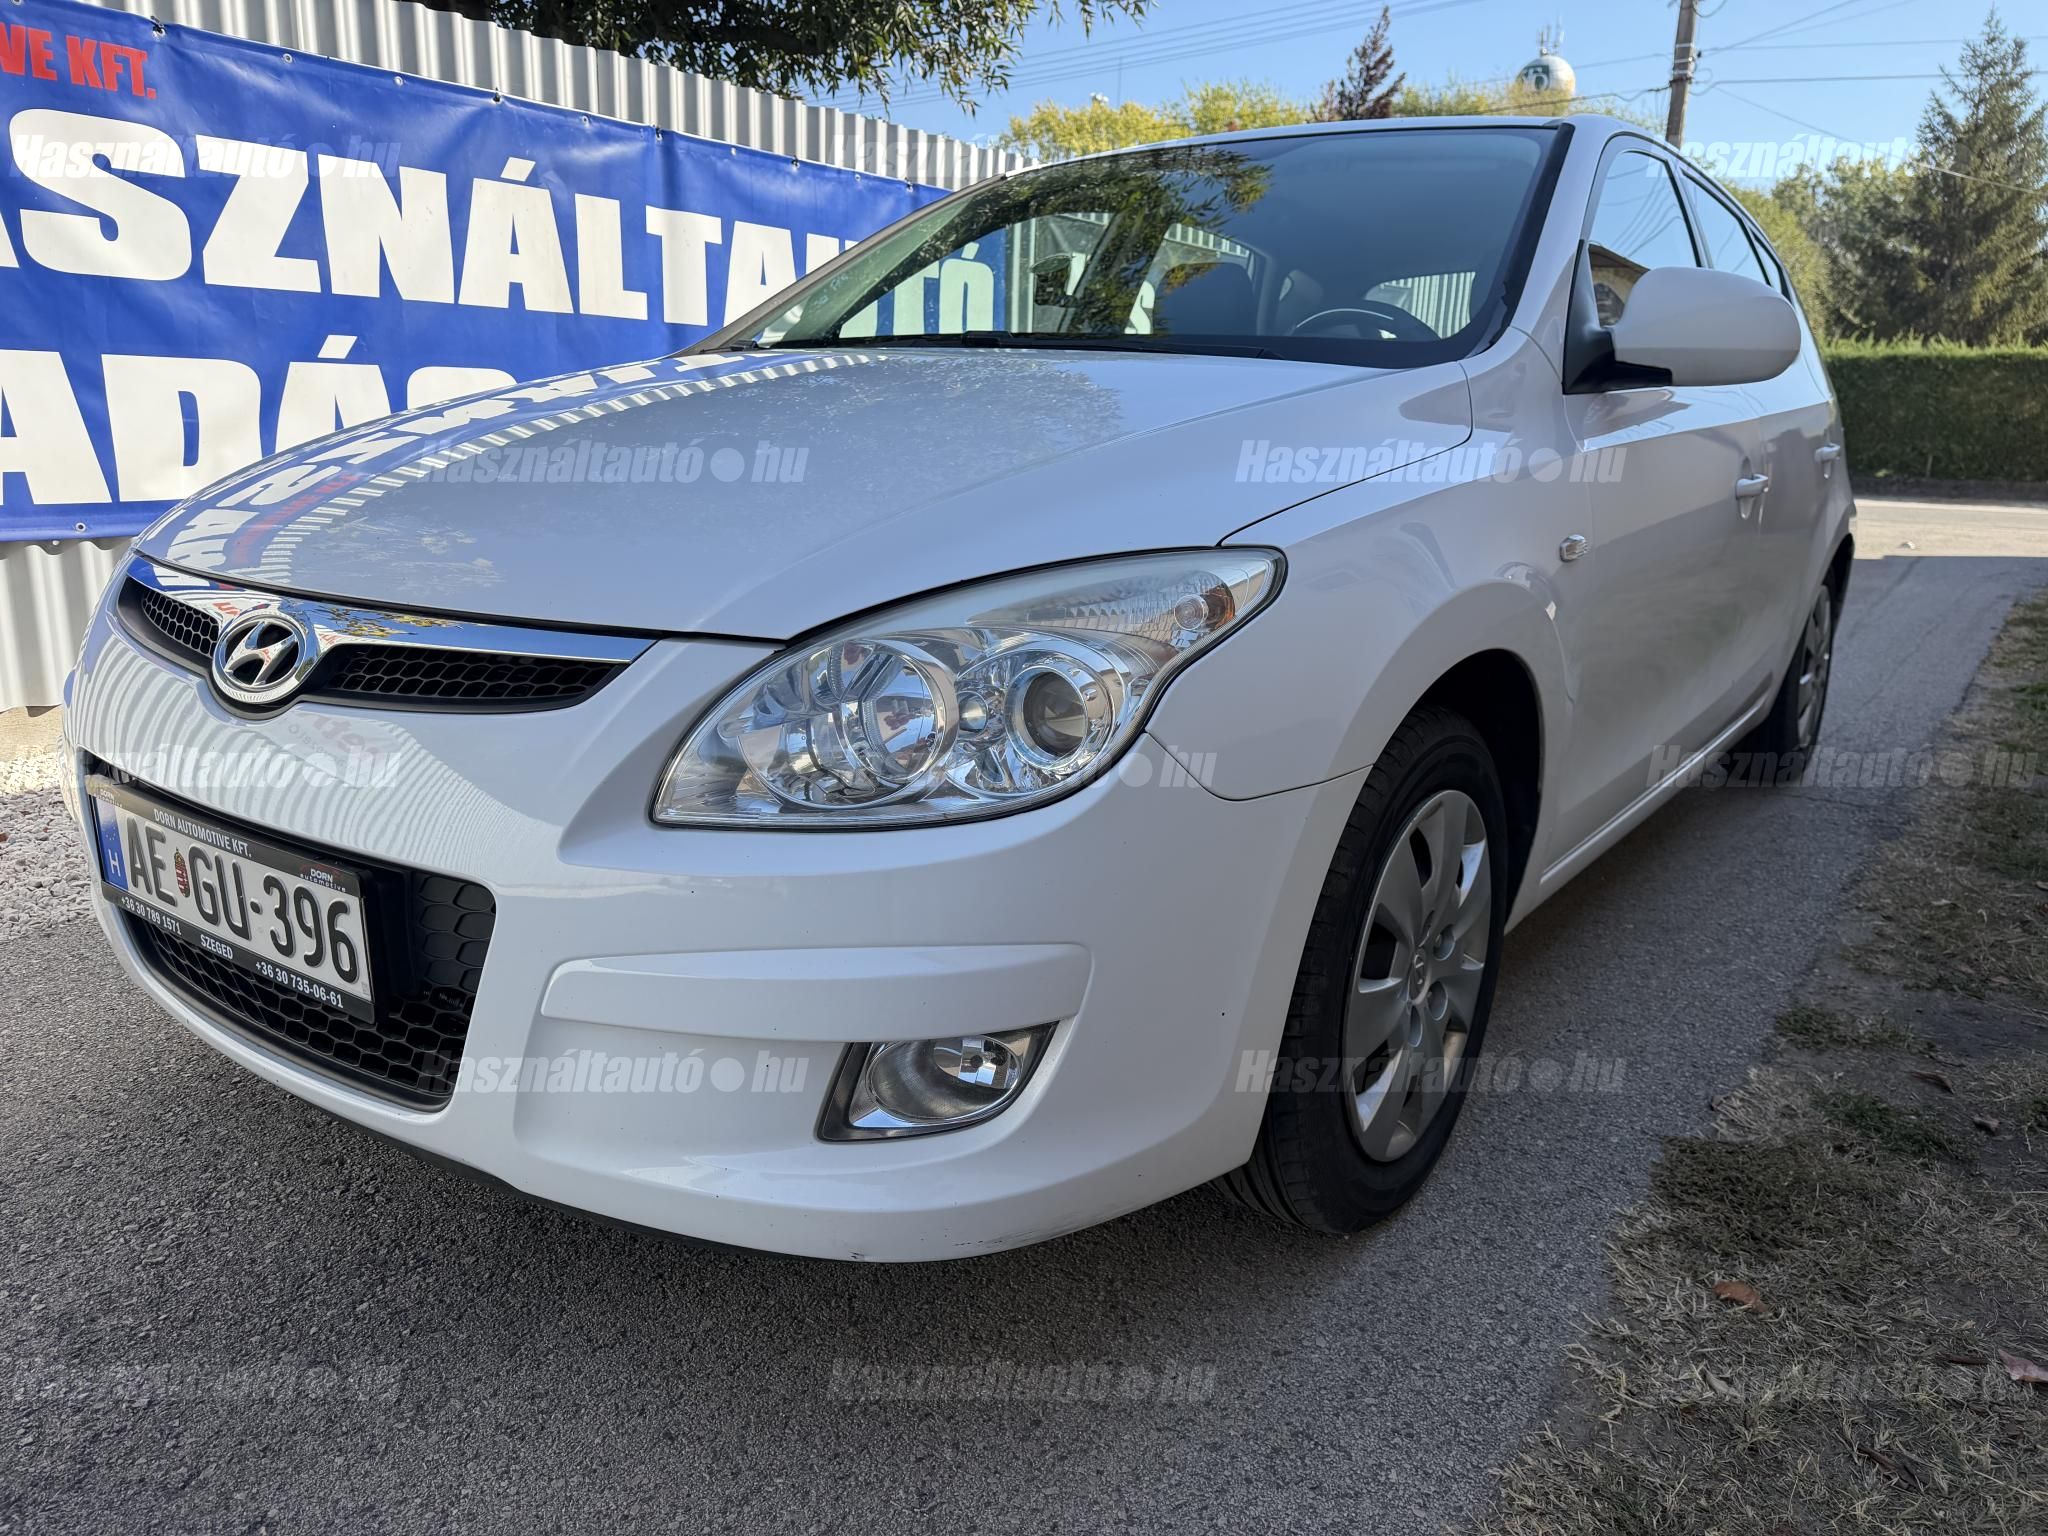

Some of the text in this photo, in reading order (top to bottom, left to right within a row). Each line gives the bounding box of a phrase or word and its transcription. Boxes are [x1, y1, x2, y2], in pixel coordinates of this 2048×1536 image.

[66, 35, 157, 100] KFT.
[153, 808, 252, 858] DORN AUTOMOTIVE KFT.
[299, 873, 346, 893] automotive
[310, 867, 334, 883] DORN
[107, 816, 359, 985] H AE GU-396
[121, 896, 182, 936] +36 30 789 1571
[200, 933, 233, 960] SZEGED
[255, 960, 274, 979] +36
[275, 967, 289, 985] 30
[290, 973, 344, 1009] 735-06-61
